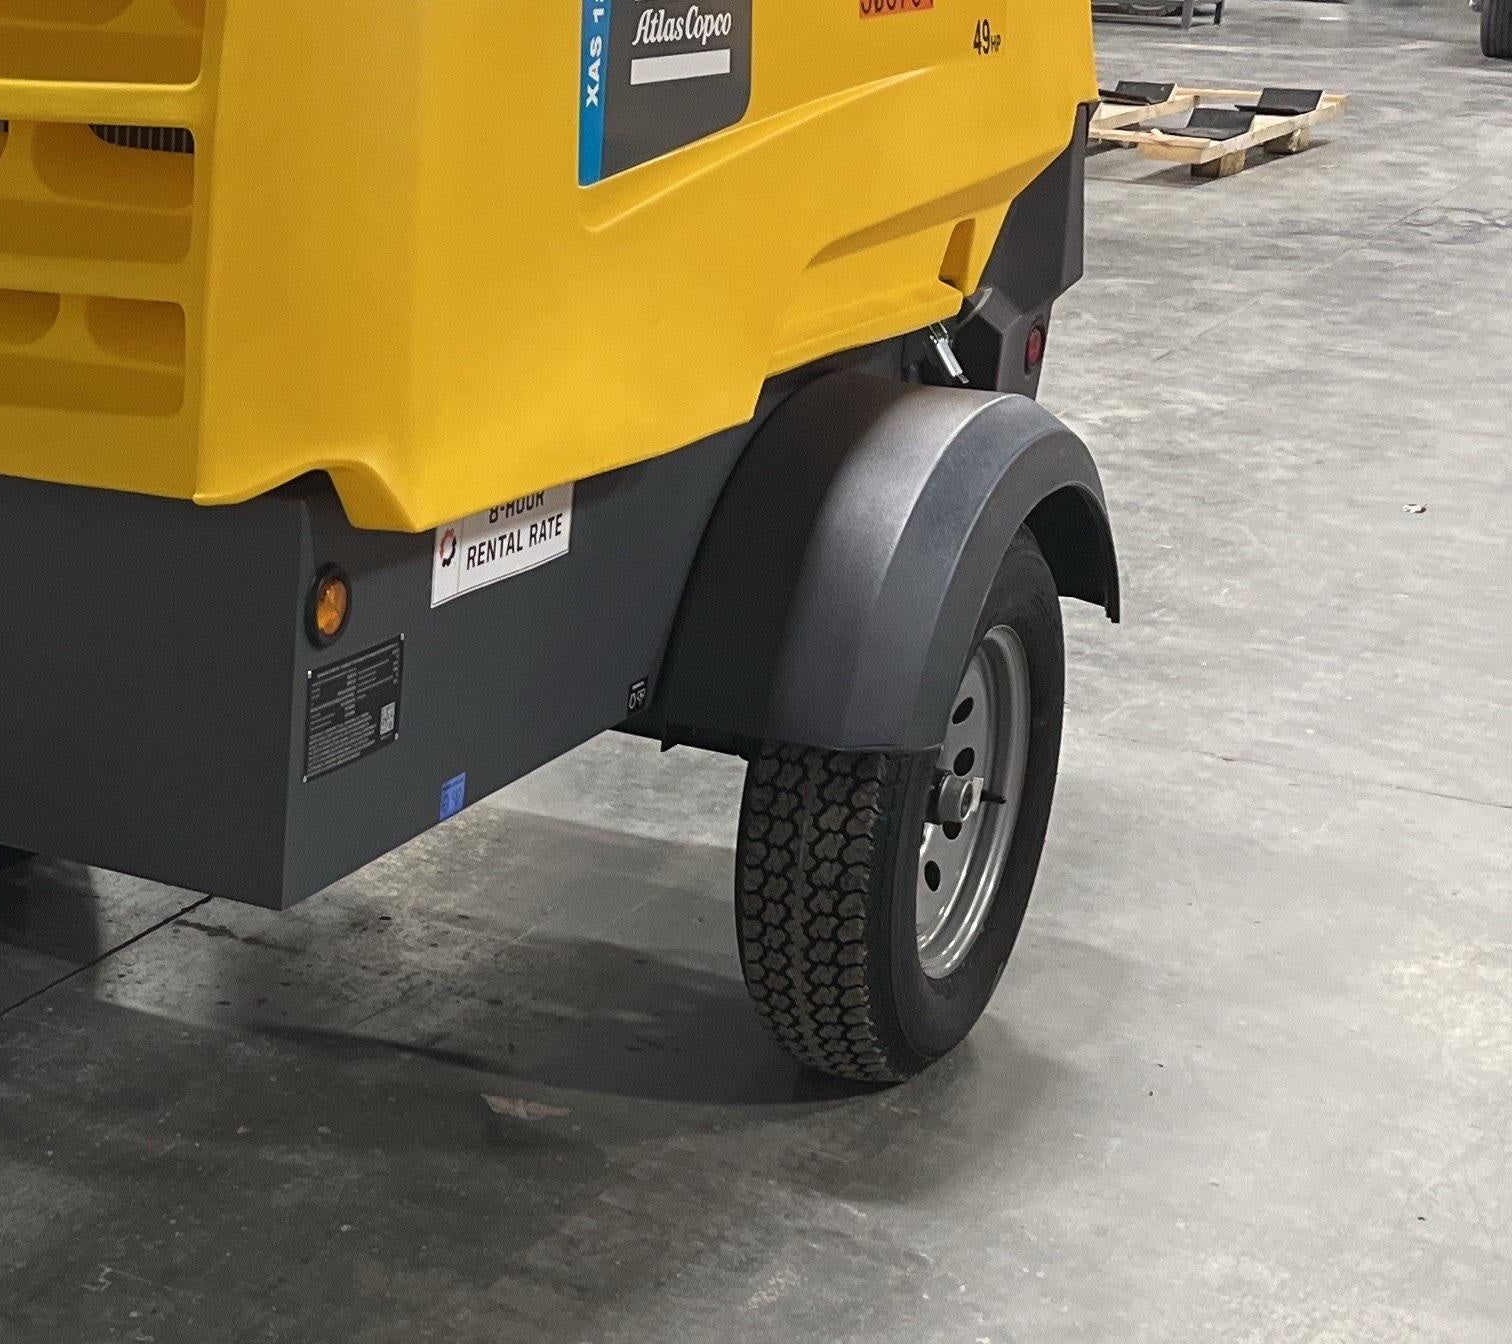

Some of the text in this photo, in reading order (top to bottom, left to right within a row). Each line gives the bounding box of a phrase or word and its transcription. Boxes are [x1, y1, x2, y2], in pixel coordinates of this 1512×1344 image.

[631, 5, 732, 46] Atlas Copco
[586, 36, 603, 107] XAS
[467, 513, 563, 570] RENTAL RATE
